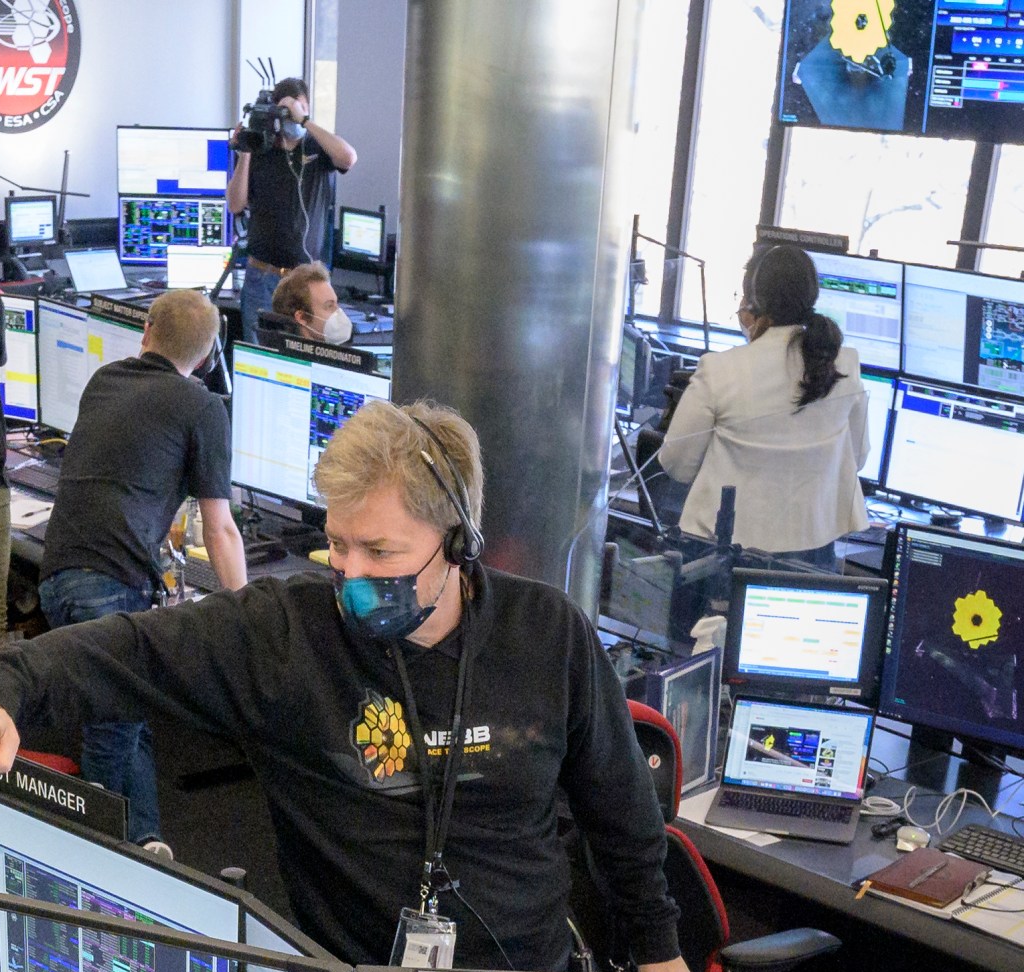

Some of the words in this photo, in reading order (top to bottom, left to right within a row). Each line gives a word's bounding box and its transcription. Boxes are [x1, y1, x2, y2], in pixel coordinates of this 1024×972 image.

[4, 114, 34, 127] ESA
[40, 90, 65, 116] CSA
[285, 339, 314, 354] TIMELINE
[315, 346, 362, 365] COORDINATOR
[16, 771, 86, 815] MANAGER
